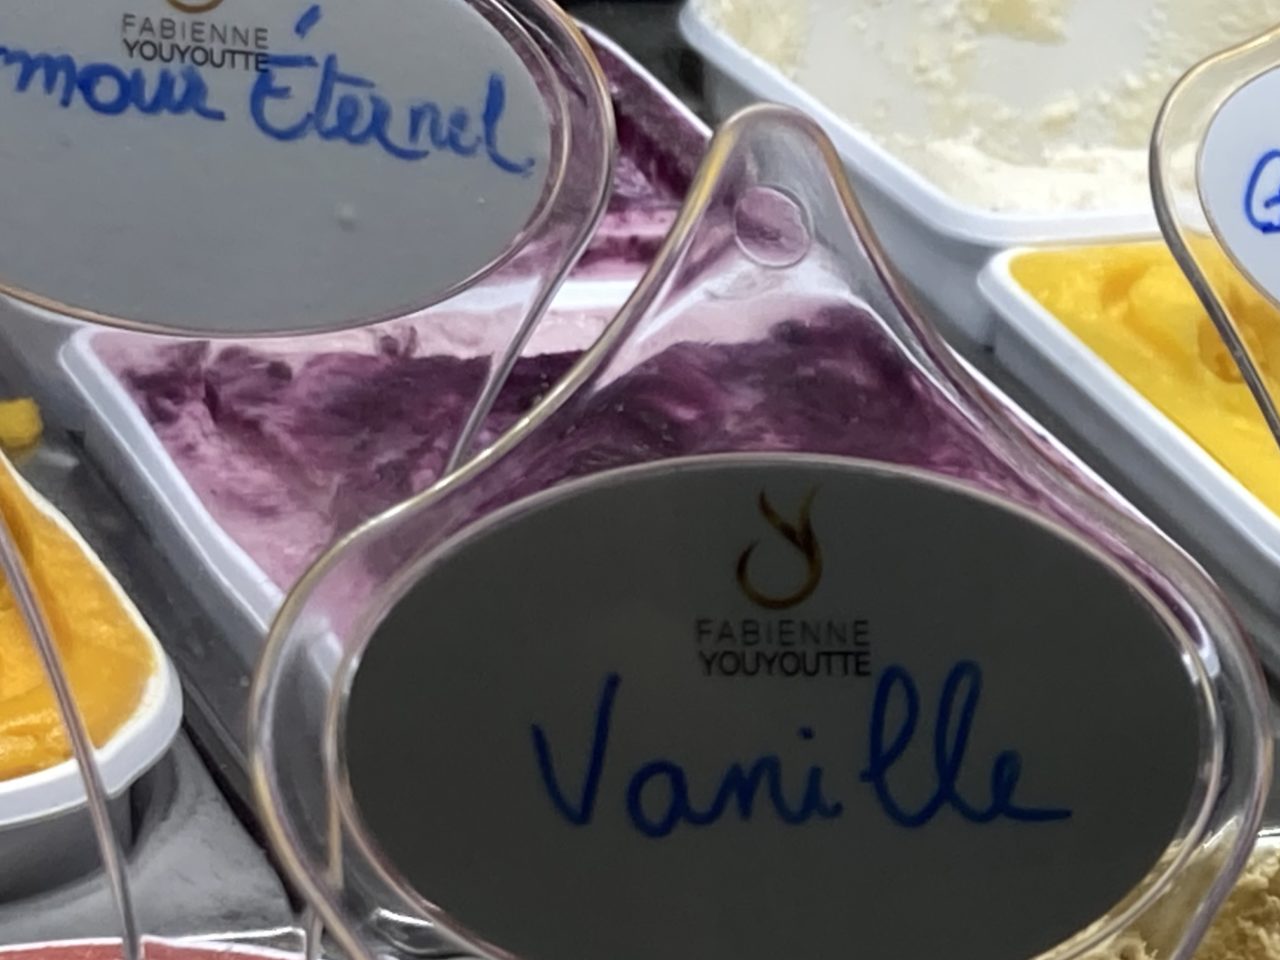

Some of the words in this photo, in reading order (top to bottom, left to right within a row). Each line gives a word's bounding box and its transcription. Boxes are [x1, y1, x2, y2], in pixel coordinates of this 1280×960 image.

[121, 13, 269, 49] FABIENNE
[122, 38, 270, 73] YOUYOUTTE
[0, 46, 226, 121] mour
[250, 4, 536, 178] Éternel
[694, 618, 871, 647] FABIENNE
[699, 650, 872, 677] YOUYOUTTE
[531, 659, 1073, 838] Vanille
